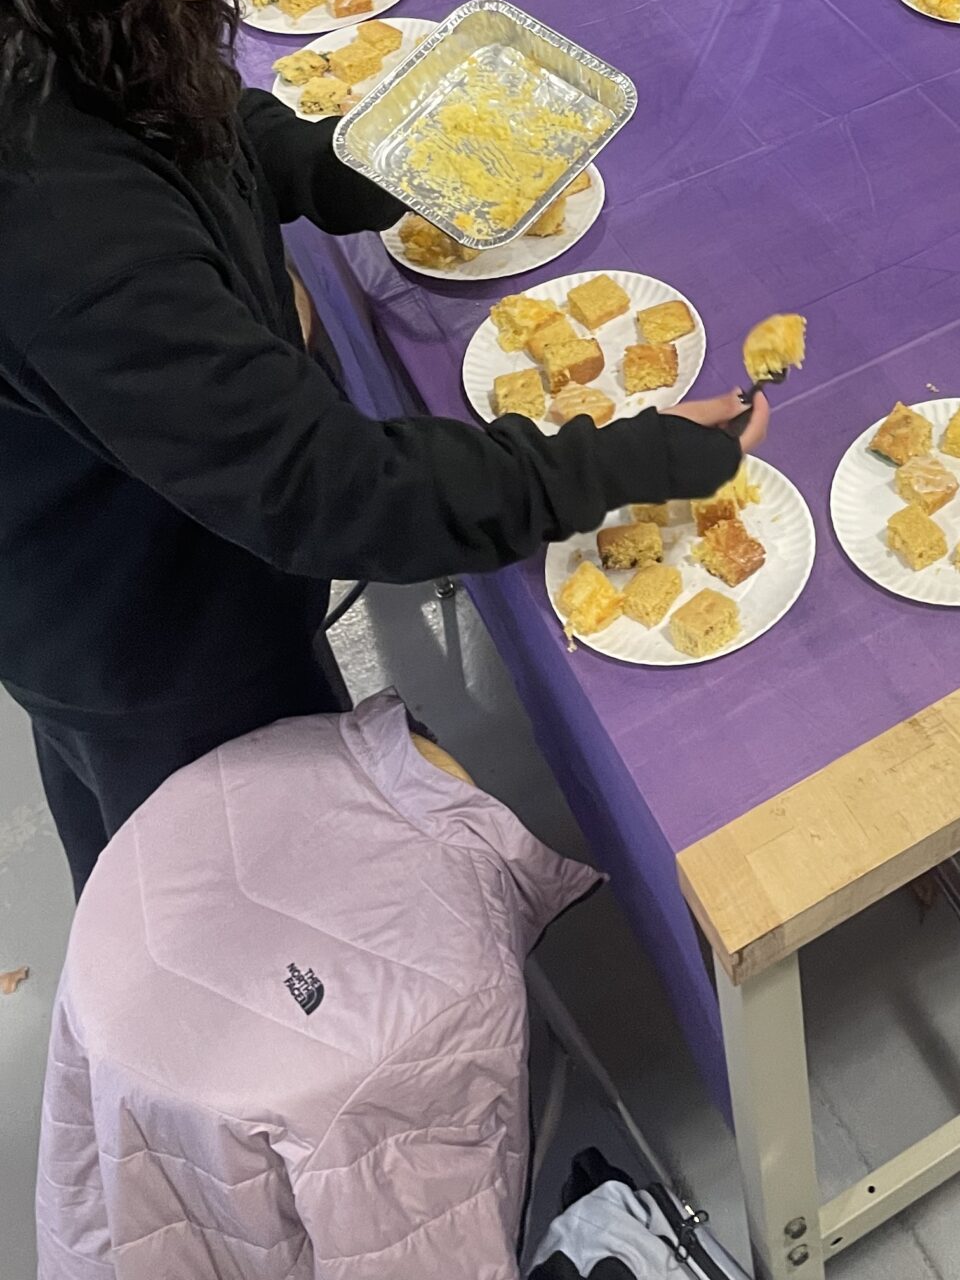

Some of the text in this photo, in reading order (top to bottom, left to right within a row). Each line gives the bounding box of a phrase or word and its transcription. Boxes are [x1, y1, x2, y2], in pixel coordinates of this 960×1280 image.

[283, 977, 306, 1003] FACE
[286, 962, 312, 994] NORTH
[304, 967, 321, 988] THE
